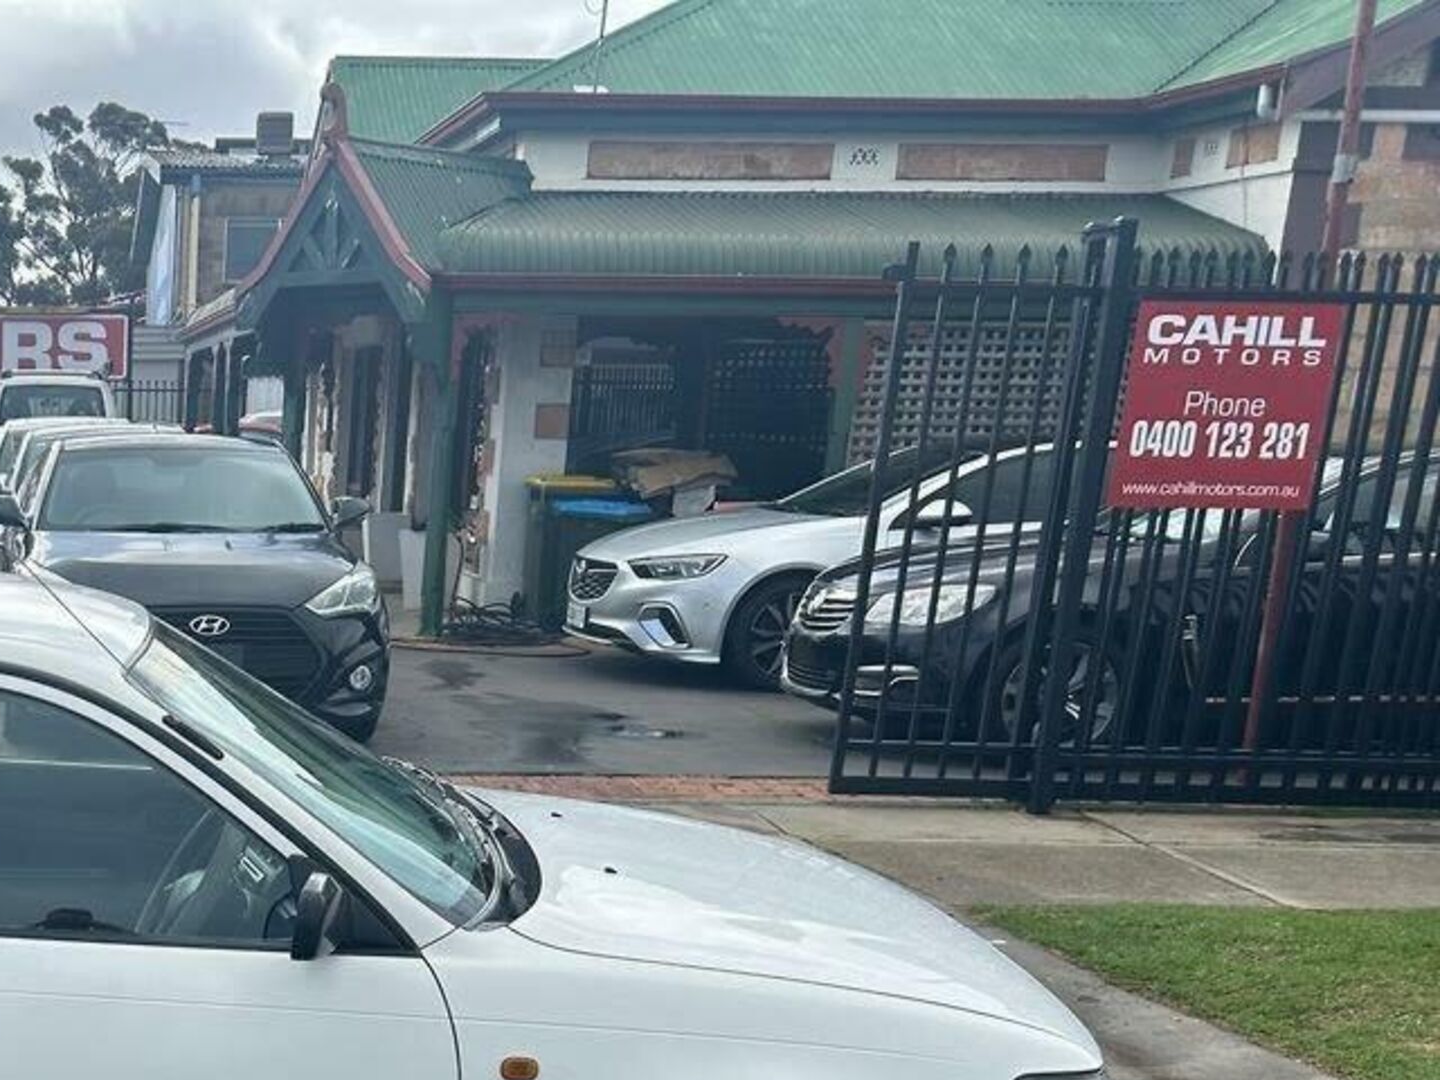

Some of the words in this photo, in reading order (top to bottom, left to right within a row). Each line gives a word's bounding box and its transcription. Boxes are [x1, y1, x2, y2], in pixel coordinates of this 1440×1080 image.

[1147, 313, 1327, 348] CAHILL
[1143, 347, 1322, 367] MOTORS
[1183, 390, 1267, 417] Phone
[1129, 419, 1198, 459] 0400
[1205, 421, 1254, 459] 123
[1258, 422, 1310, 460] 281
[1121, 480, 1301, 498] www.cahillmotors.com.au
